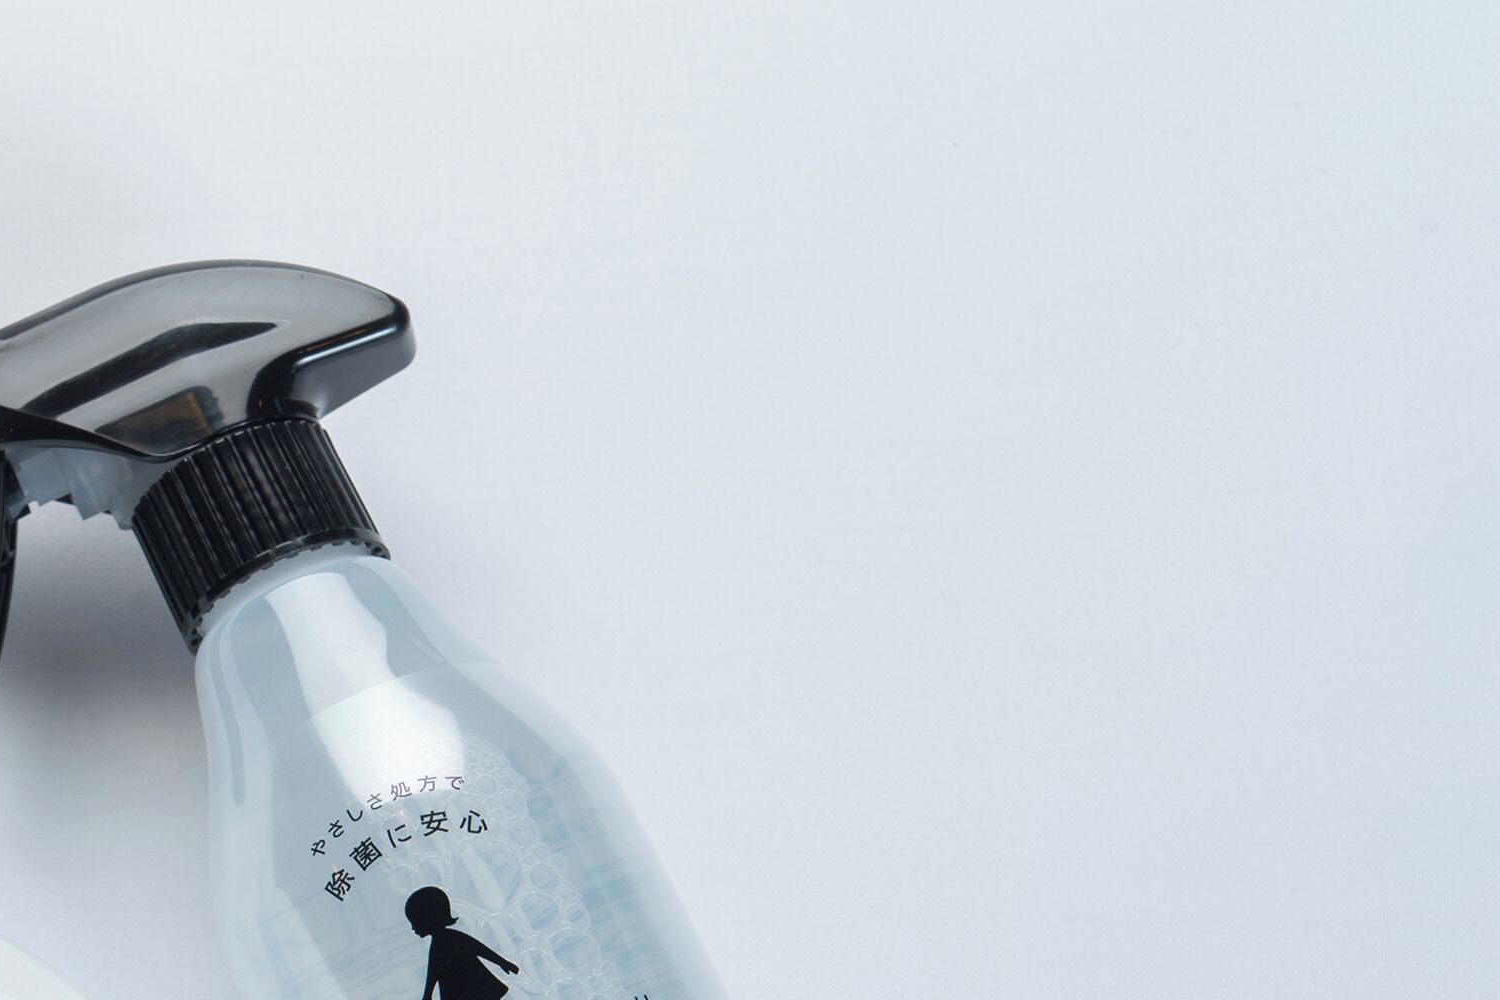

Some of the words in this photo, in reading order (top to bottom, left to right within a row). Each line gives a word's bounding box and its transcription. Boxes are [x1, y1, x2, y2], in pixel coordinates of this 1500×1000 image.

[311, 775, 465, 857] やさしさ処方で
[324, 810, 488, 901] 除菌に安心
